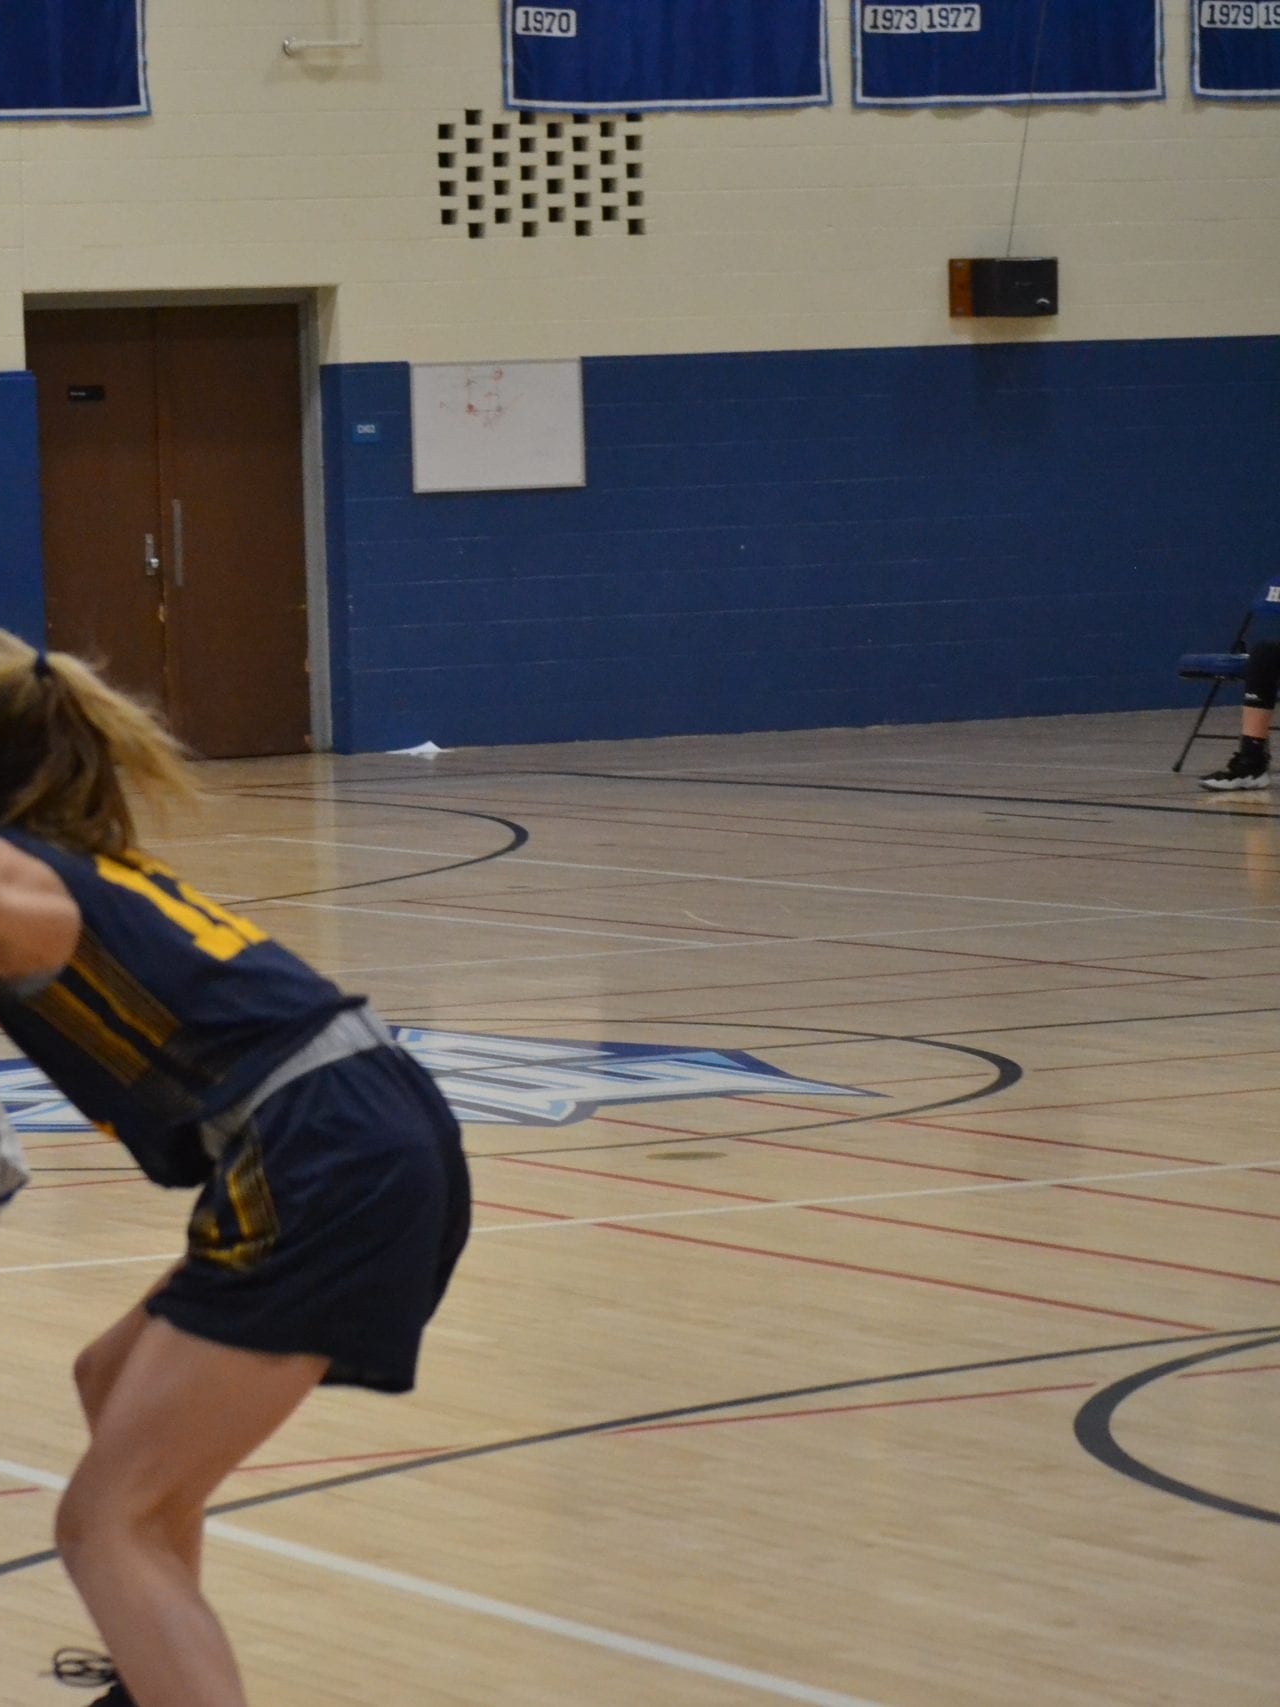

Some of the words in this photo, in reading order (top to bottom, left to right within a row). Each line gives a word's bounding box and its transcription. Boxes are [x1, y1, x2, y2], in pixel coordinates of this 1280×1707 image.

[521, 10, 571, 33] 1970
[869, 8, 918, 30] 1973
[926, 6, 977, 29] 1977
[1206, 4, 1254, 25] 1979
[1264, 5, 1280, 25] 19
